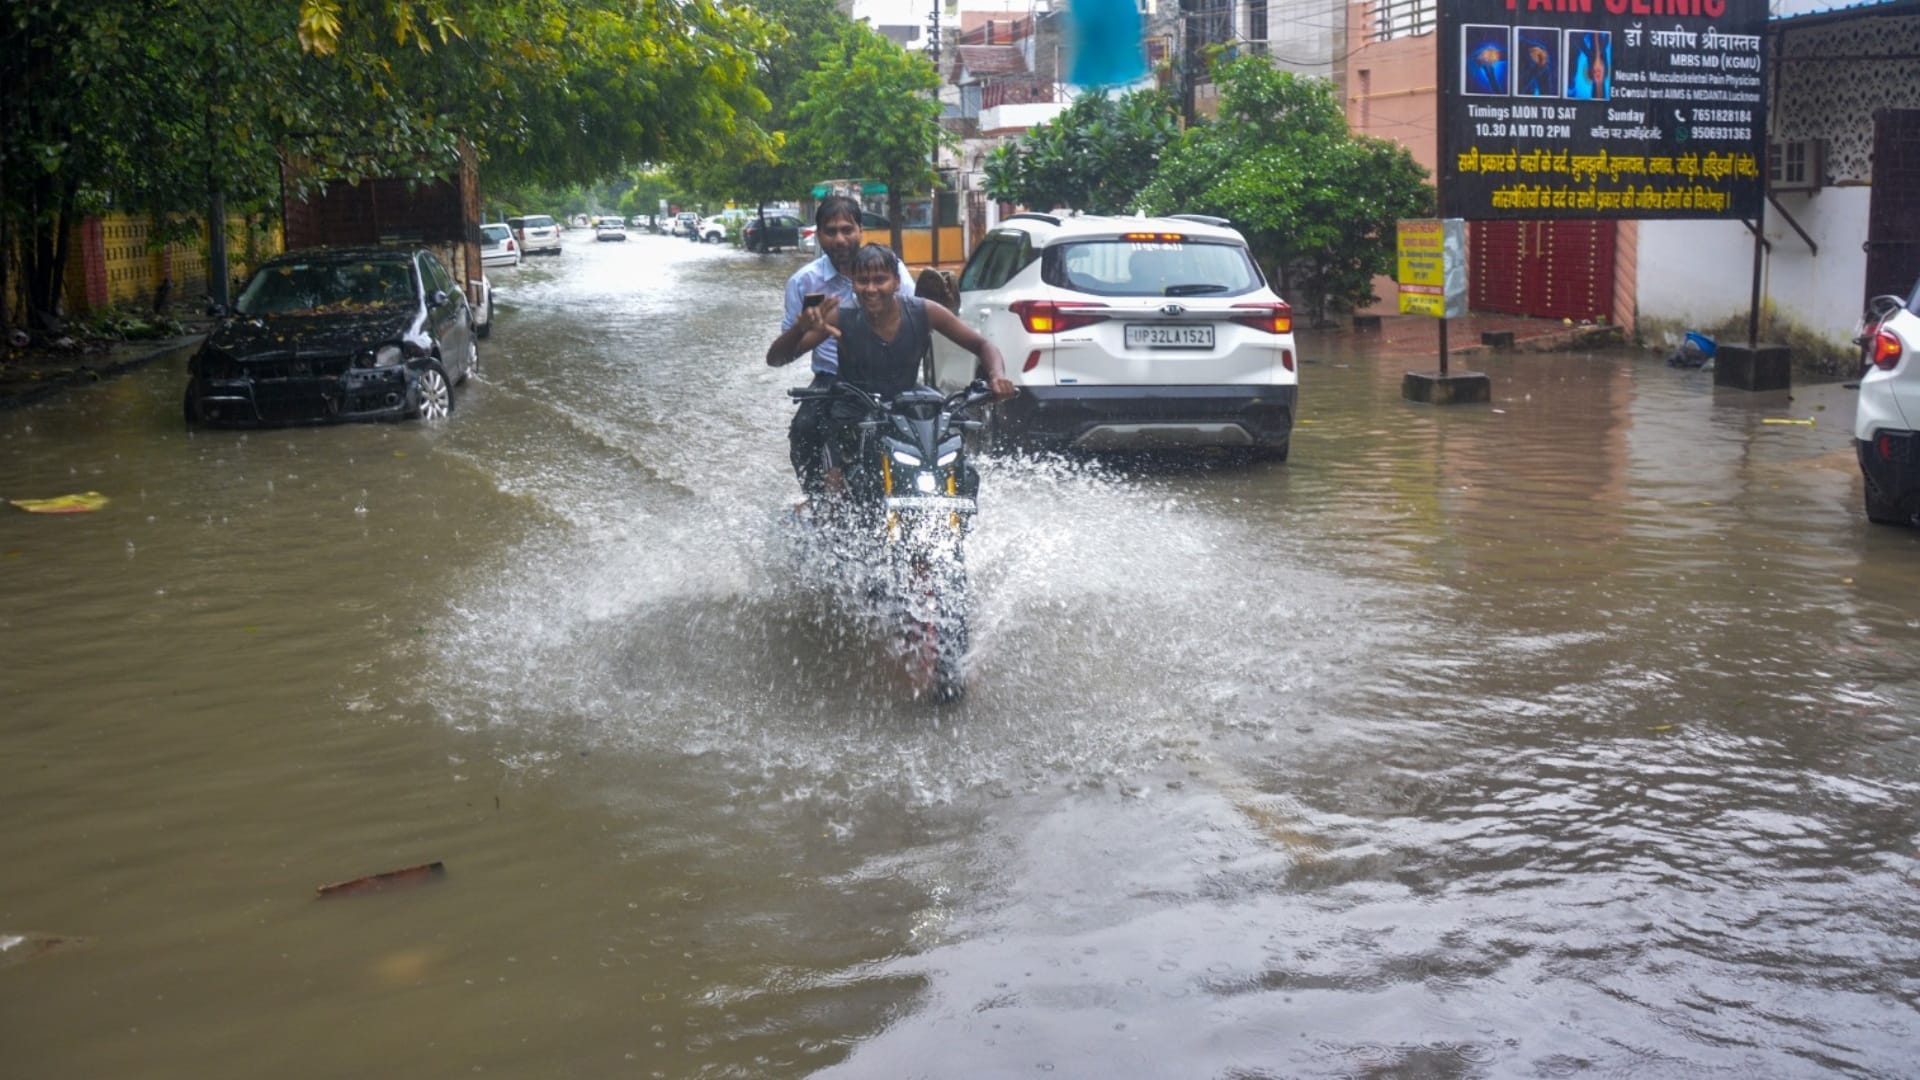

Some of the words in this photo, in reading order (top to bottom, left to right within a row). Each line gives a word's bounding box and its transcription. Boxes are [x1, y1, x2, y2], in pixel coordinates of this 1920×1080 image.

[1651, 24, 1698, 49] आशीष
[1702, 26, 1761, 51] श्रीवास्तव
[1670, 53, 1700, 67] MBBS
[1702, 55, 1719, 67] MD
[1721, 52, 1761, 72] (KGMU)
[1708, 74, 1725, 85] Pain
[1725, 74, 1760, 88] Physician
[1468, 104, 1509, 120] Timings
[1512, 105, 1538, 119] MON
[1541, 106, 1555, 119] TO
[1557, 107, 1577, 120] SAT
[1608, 108, 1646, 124] Sunday
[1692, 108, 1752, 122] 7651828184
[1475, 123, 1506, 137] 10.30
[1530, 125, 1544, 137] TO
[1547, 125, 1570, 138] 2PM
[1458, 146, 1478, 172] सभी
[1480, 154, 1505, 175] प्रकार
[1506, 148, 1517, 172] के
[1541, 149, 1552, 172] के
[1541, 184, 1551, 208] के
[1552, 184, 1568, 208] दर्द
[1577, 185, 1596, 209] सभी
[1134, 329, 1211, 344] UP32LA1521
